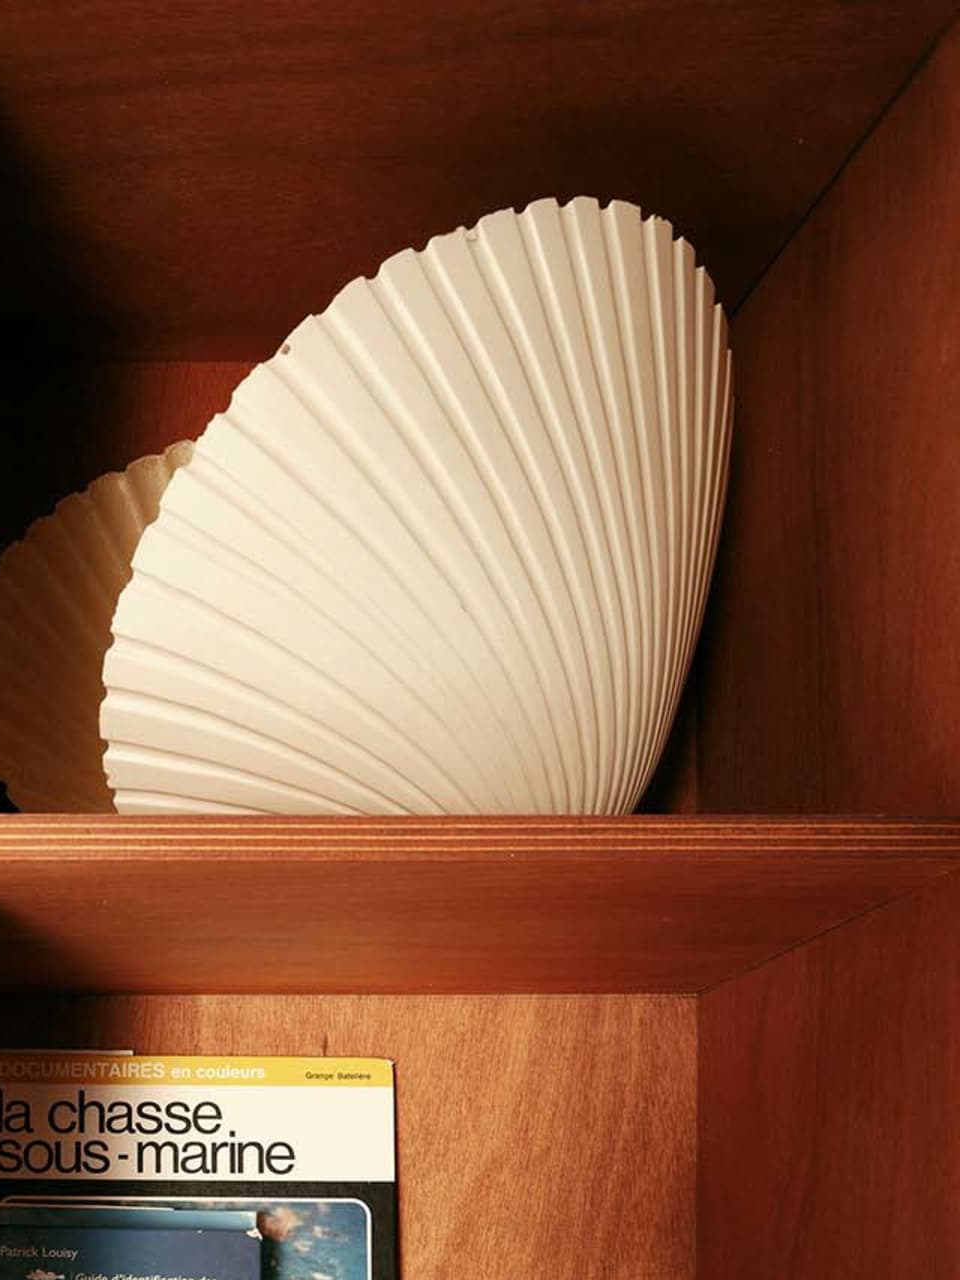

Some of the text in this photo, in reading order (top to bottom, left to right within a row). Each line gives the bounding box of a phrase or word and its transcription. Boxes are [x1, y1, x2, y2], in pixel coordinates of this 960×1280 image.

[0, 1061, 265, 1080] DOCUMENTAIRES en couleurs
[47, 1089, 223, 1135] chasse
[0, 1245, 79, 1262] Patrick Louisy
